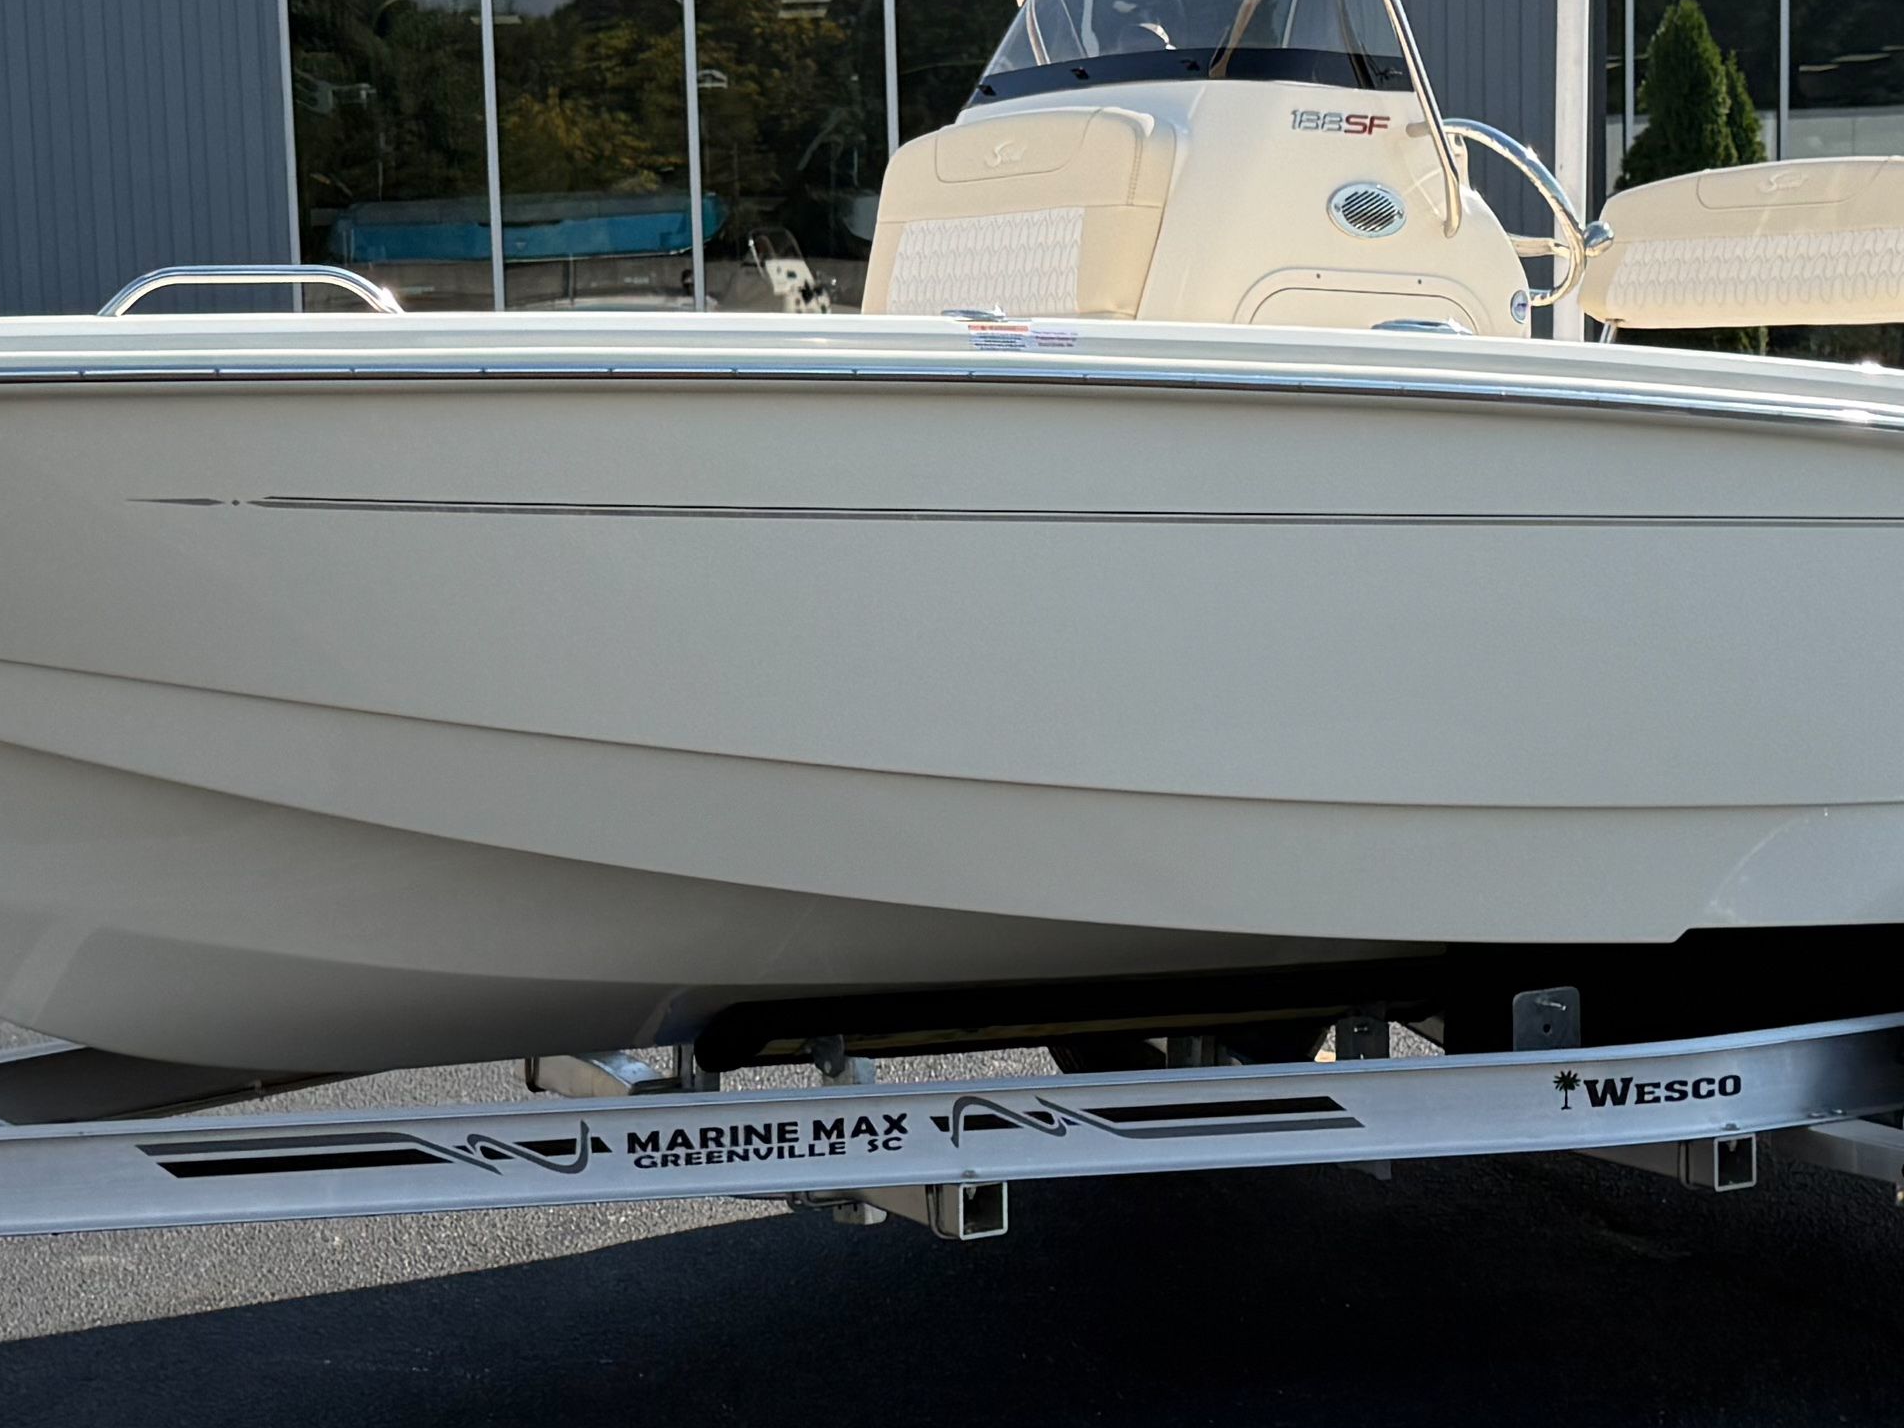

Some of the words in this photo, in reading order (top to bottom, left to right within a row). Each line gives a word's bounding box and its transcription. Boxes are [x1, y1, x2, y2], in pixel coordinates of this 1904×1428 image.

[1290, 108, 1391, 136] 188SF
[626, 1121, 800, 1154] MARINE
[812, 1112, 908, 1142] MAX
[633, 1141, 847, 1169] GREENVILLE
[867, 1136, 903, 1153] SC
